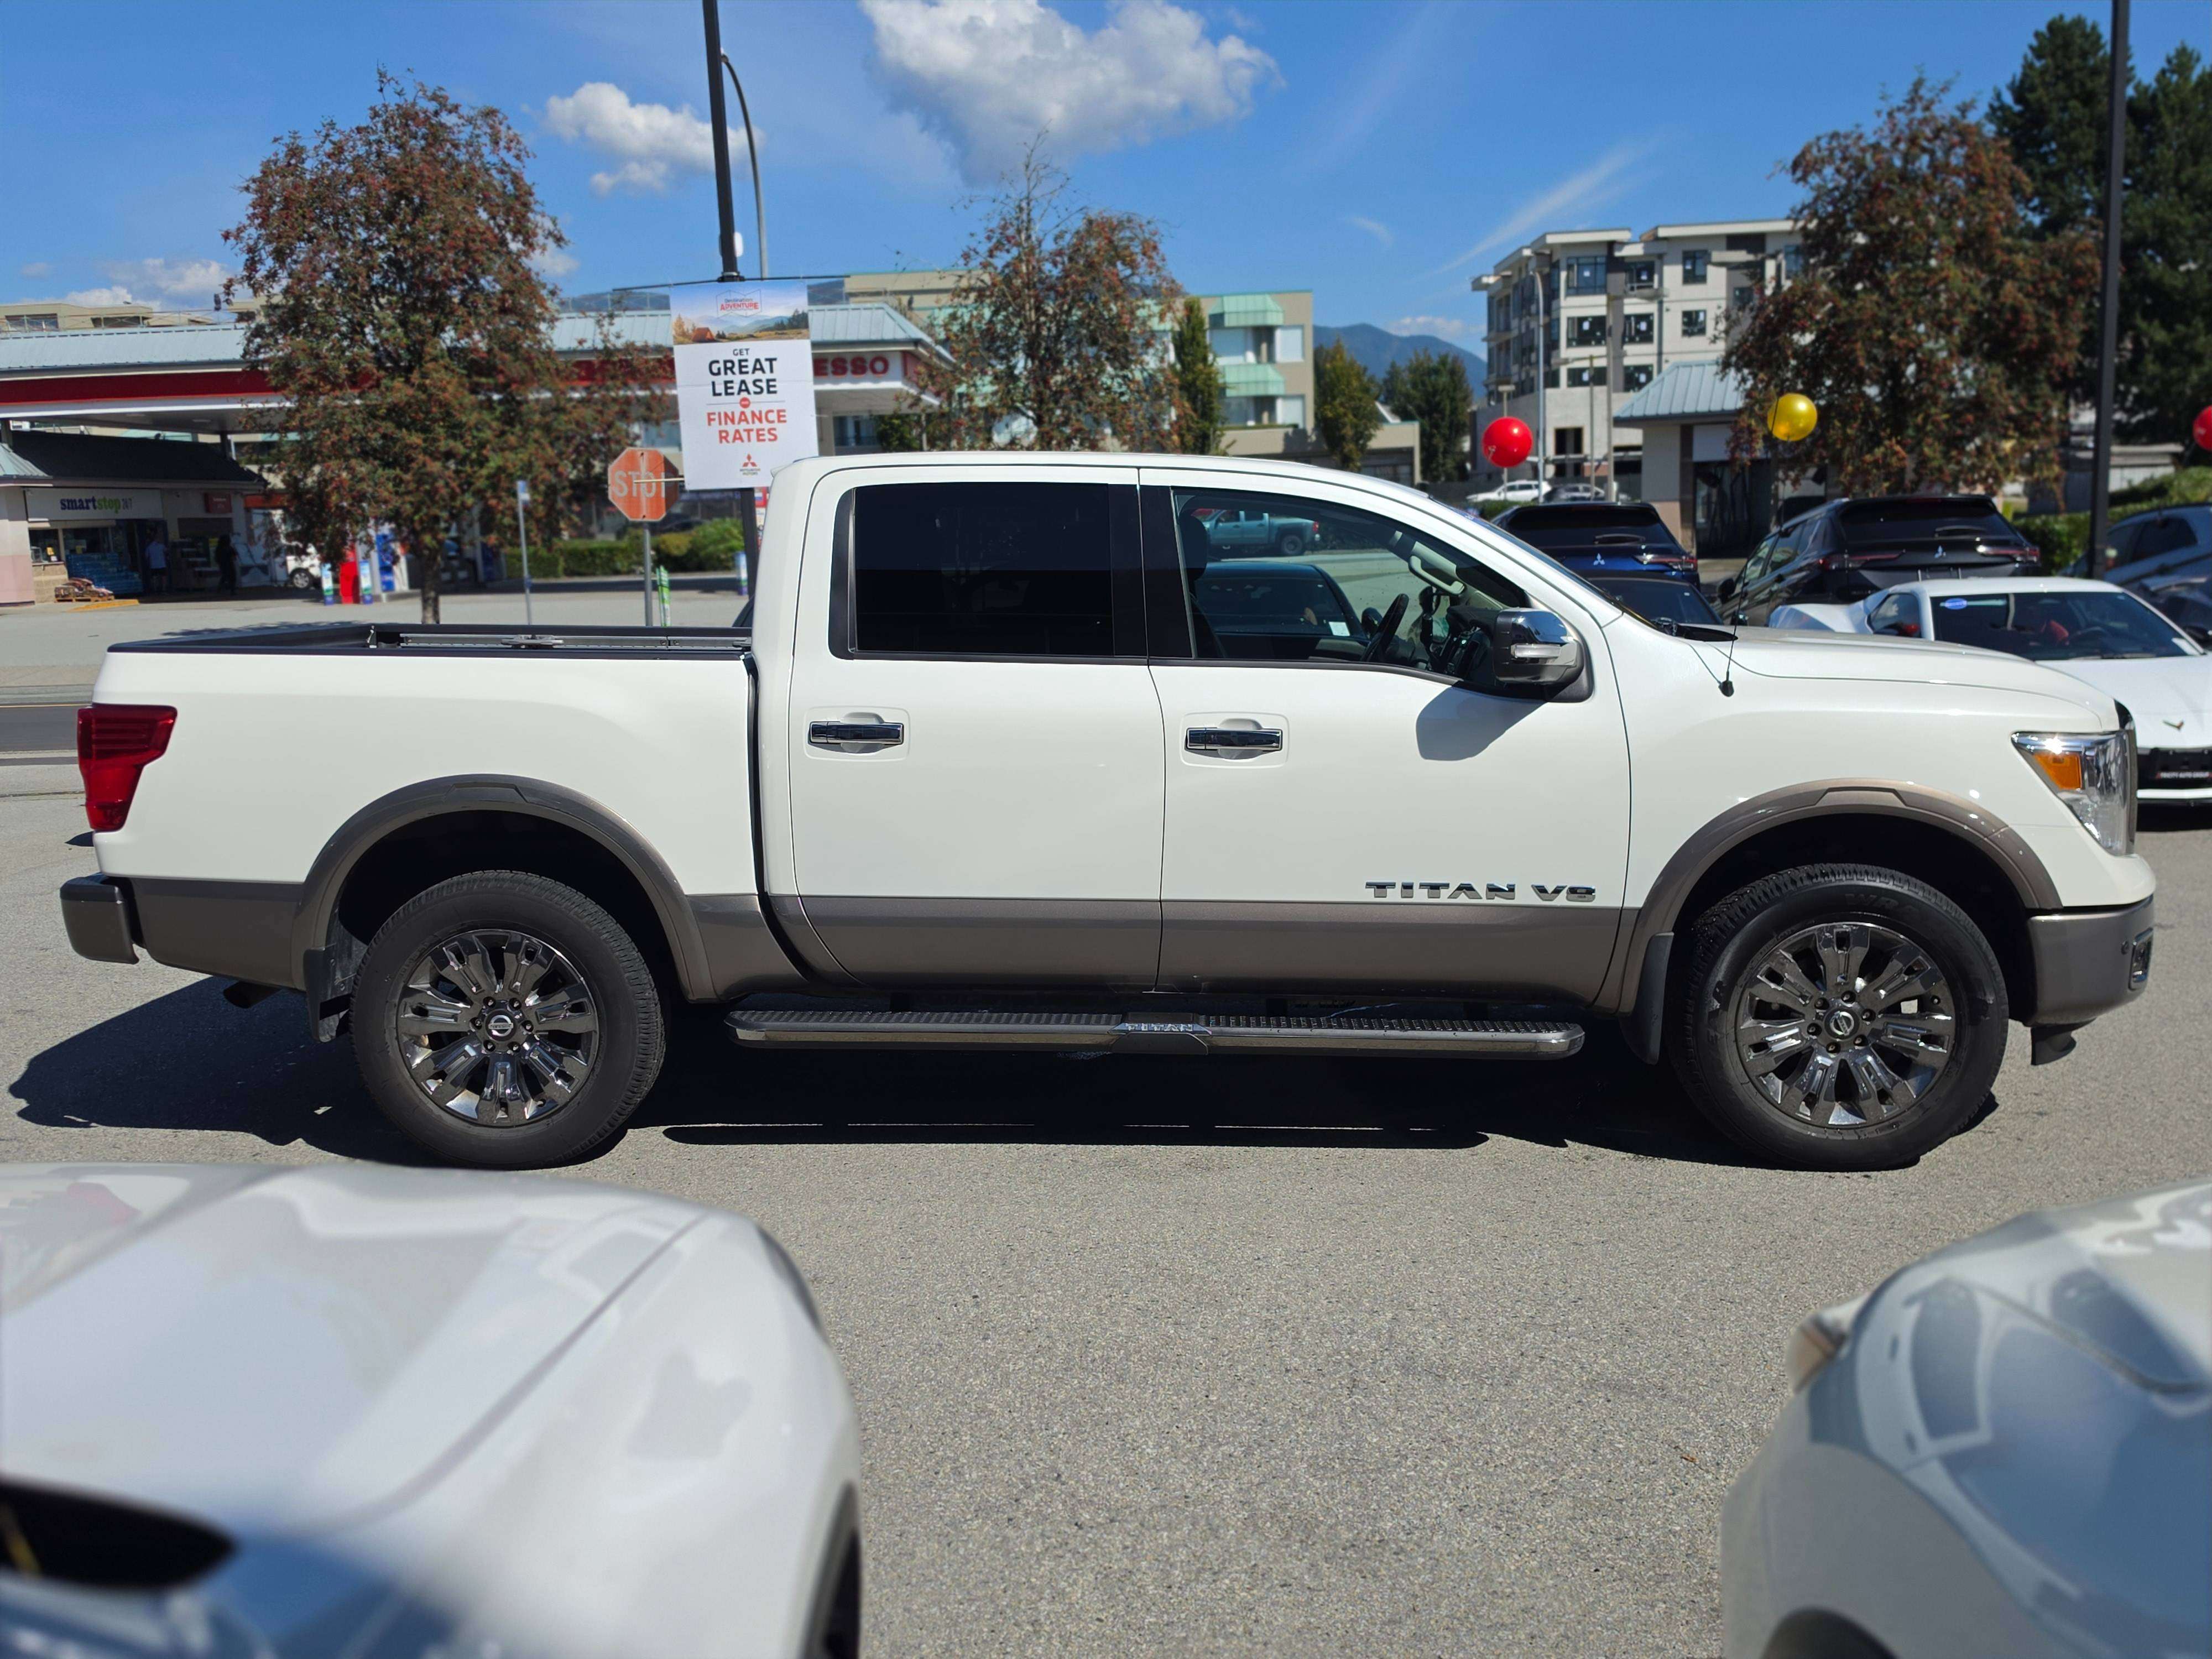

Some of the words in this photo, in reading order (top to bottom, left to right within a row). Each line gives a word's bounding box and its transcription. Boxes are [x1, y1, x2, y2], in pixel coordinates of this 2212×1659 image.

[720, 302, 760, 311] ADVENTURE
[708, 358, 778, 376] GREAT
[813, 356, 890, 377] ESSO
[711, 378, 778, 397] LEASE
[707, 409, 787, 426] FINANCE
[718, 427, 778, 444] RATES
[1365, 881, 1516, 900] TITAN
[1531, 884, 1596, 902] V8
[1125, 1023, 1193, 1031] TITAN
